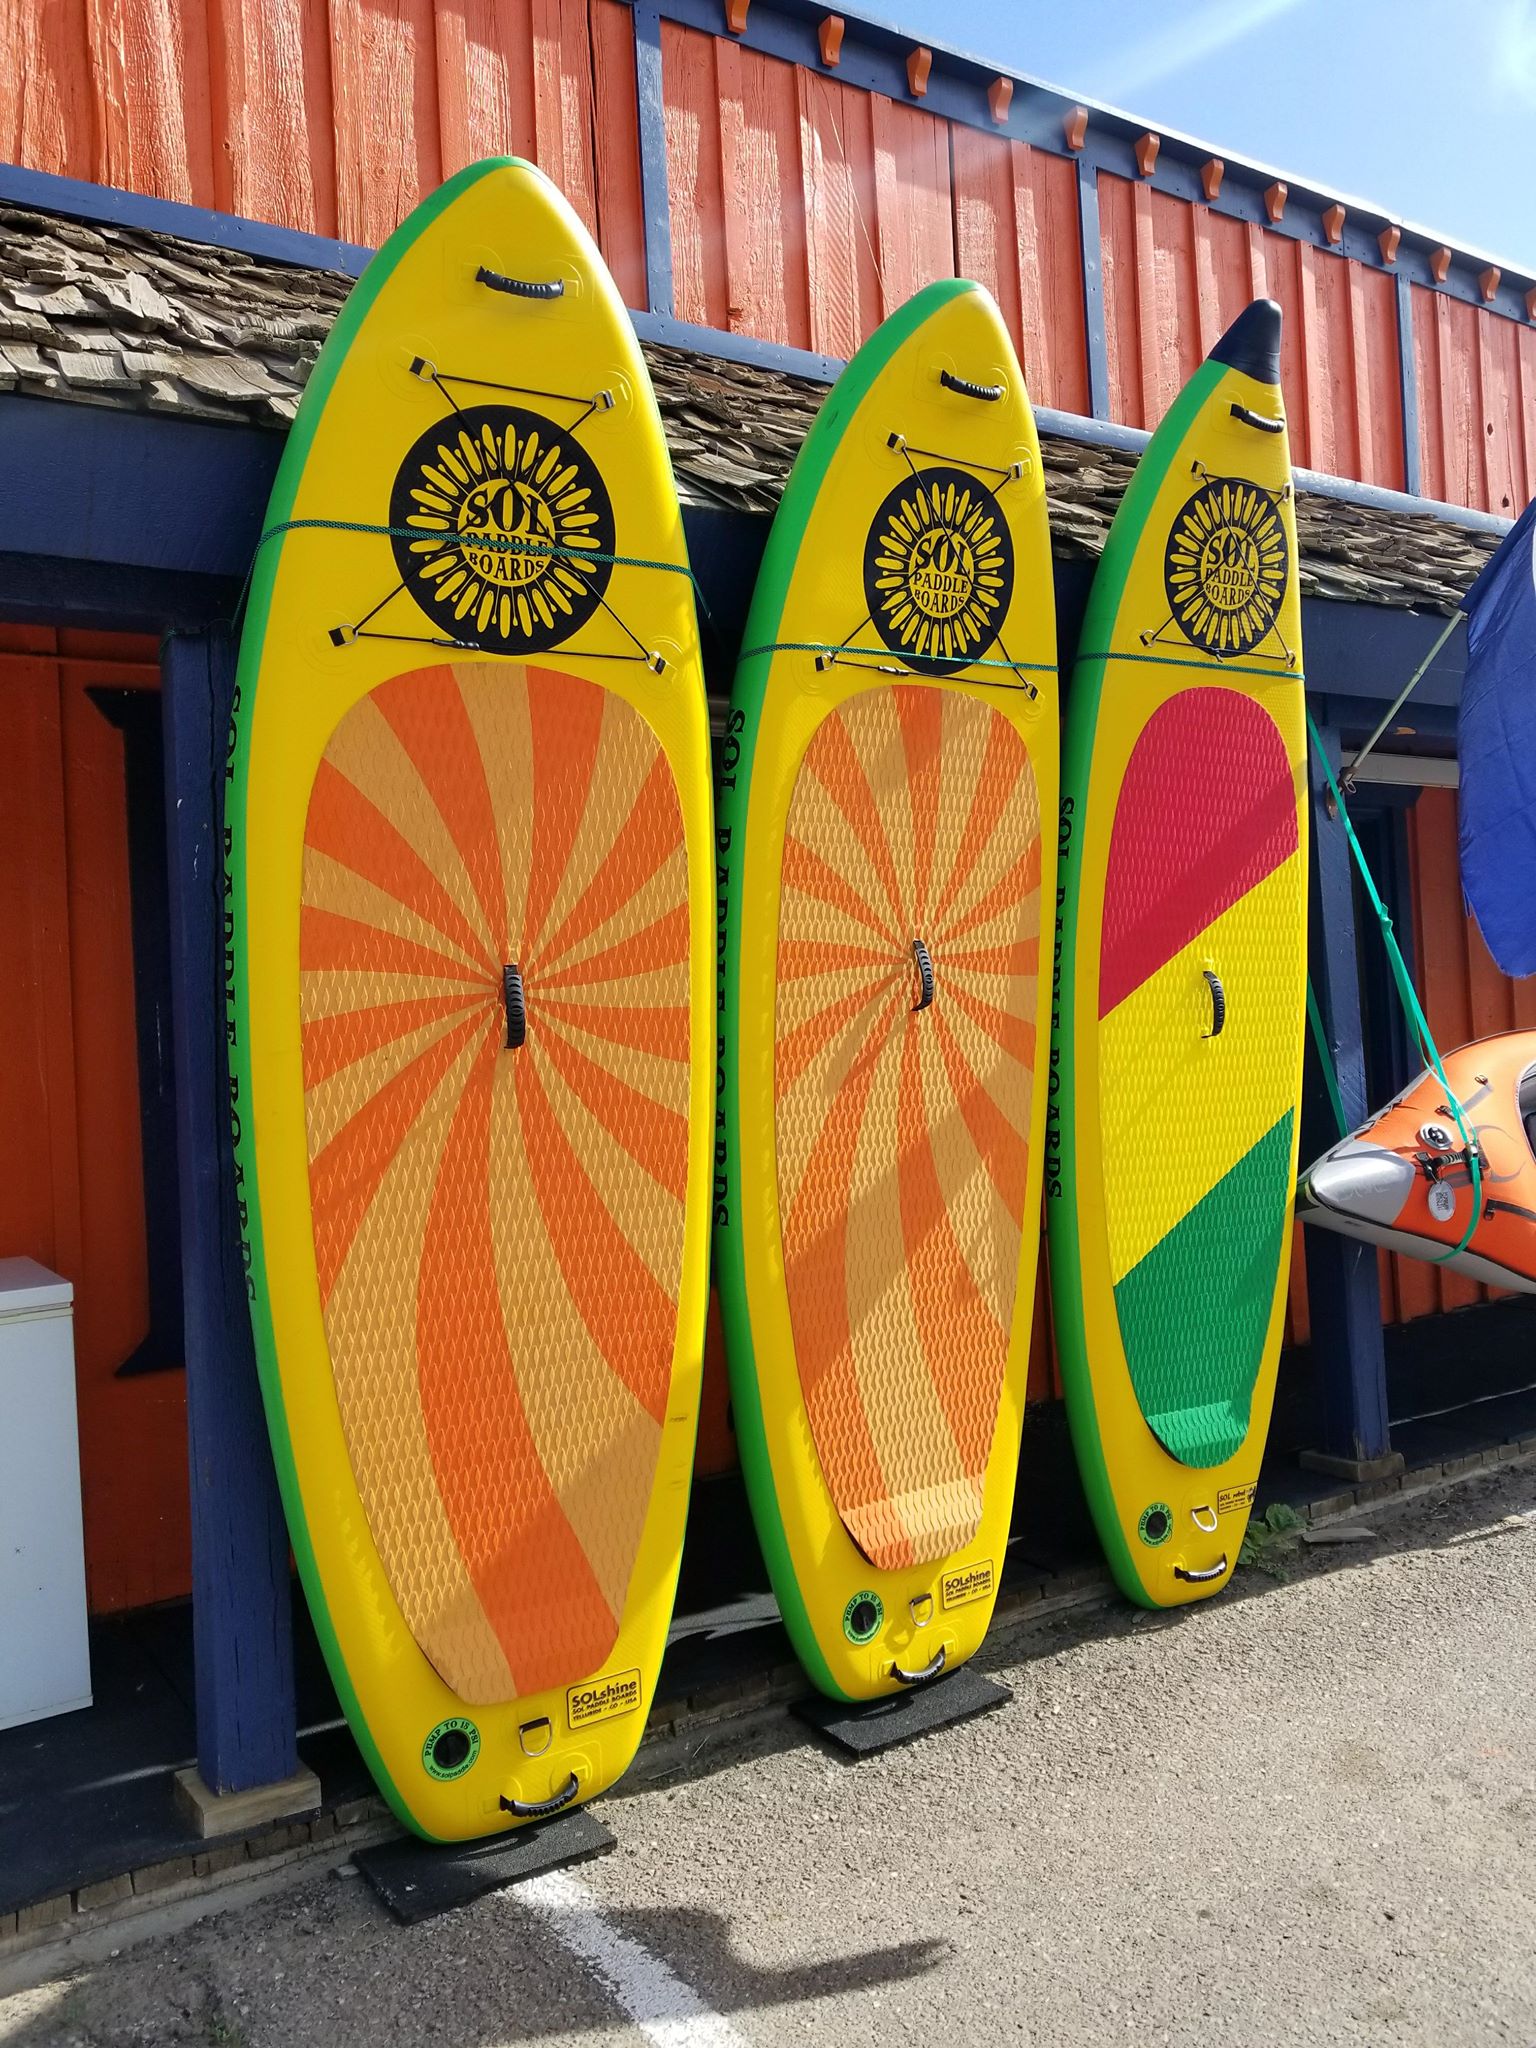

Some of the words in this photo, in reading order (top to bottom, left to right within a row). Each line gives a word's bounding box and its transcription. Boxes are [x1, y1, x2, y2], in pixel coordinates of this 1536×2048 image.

[466, 483, 550, 538] SOL
[915, 533, 971, 576] SOL
[1206, 531, 1255, 571] SOL
[469, 553, 545, 582] BOARDS
[1205, 567, 1254, 588] PADDLE
[913, 573, 968, 594] PADDLE
[1205, 584, 1251, 606] BOARDS
[914, 589, 965, 613] BOARDS
[945, 1570, 991, 1592] SOLshine
[844, 1598, 858, 1621] PUMP
[859, 1592, 869, 1600] TO
[572, 1681, 637, 1708] SOLshine
[572, 1706, 584, 1715] SOL
[587, 1699, 609, 1709] PADDLE
[611, 1690, 637, 1702] BOARDS
[425, 1729, 441, 1757] PUMP
[444, 1720, 458, 1730] TO
[470, 1729, 479, 1744] PSI
